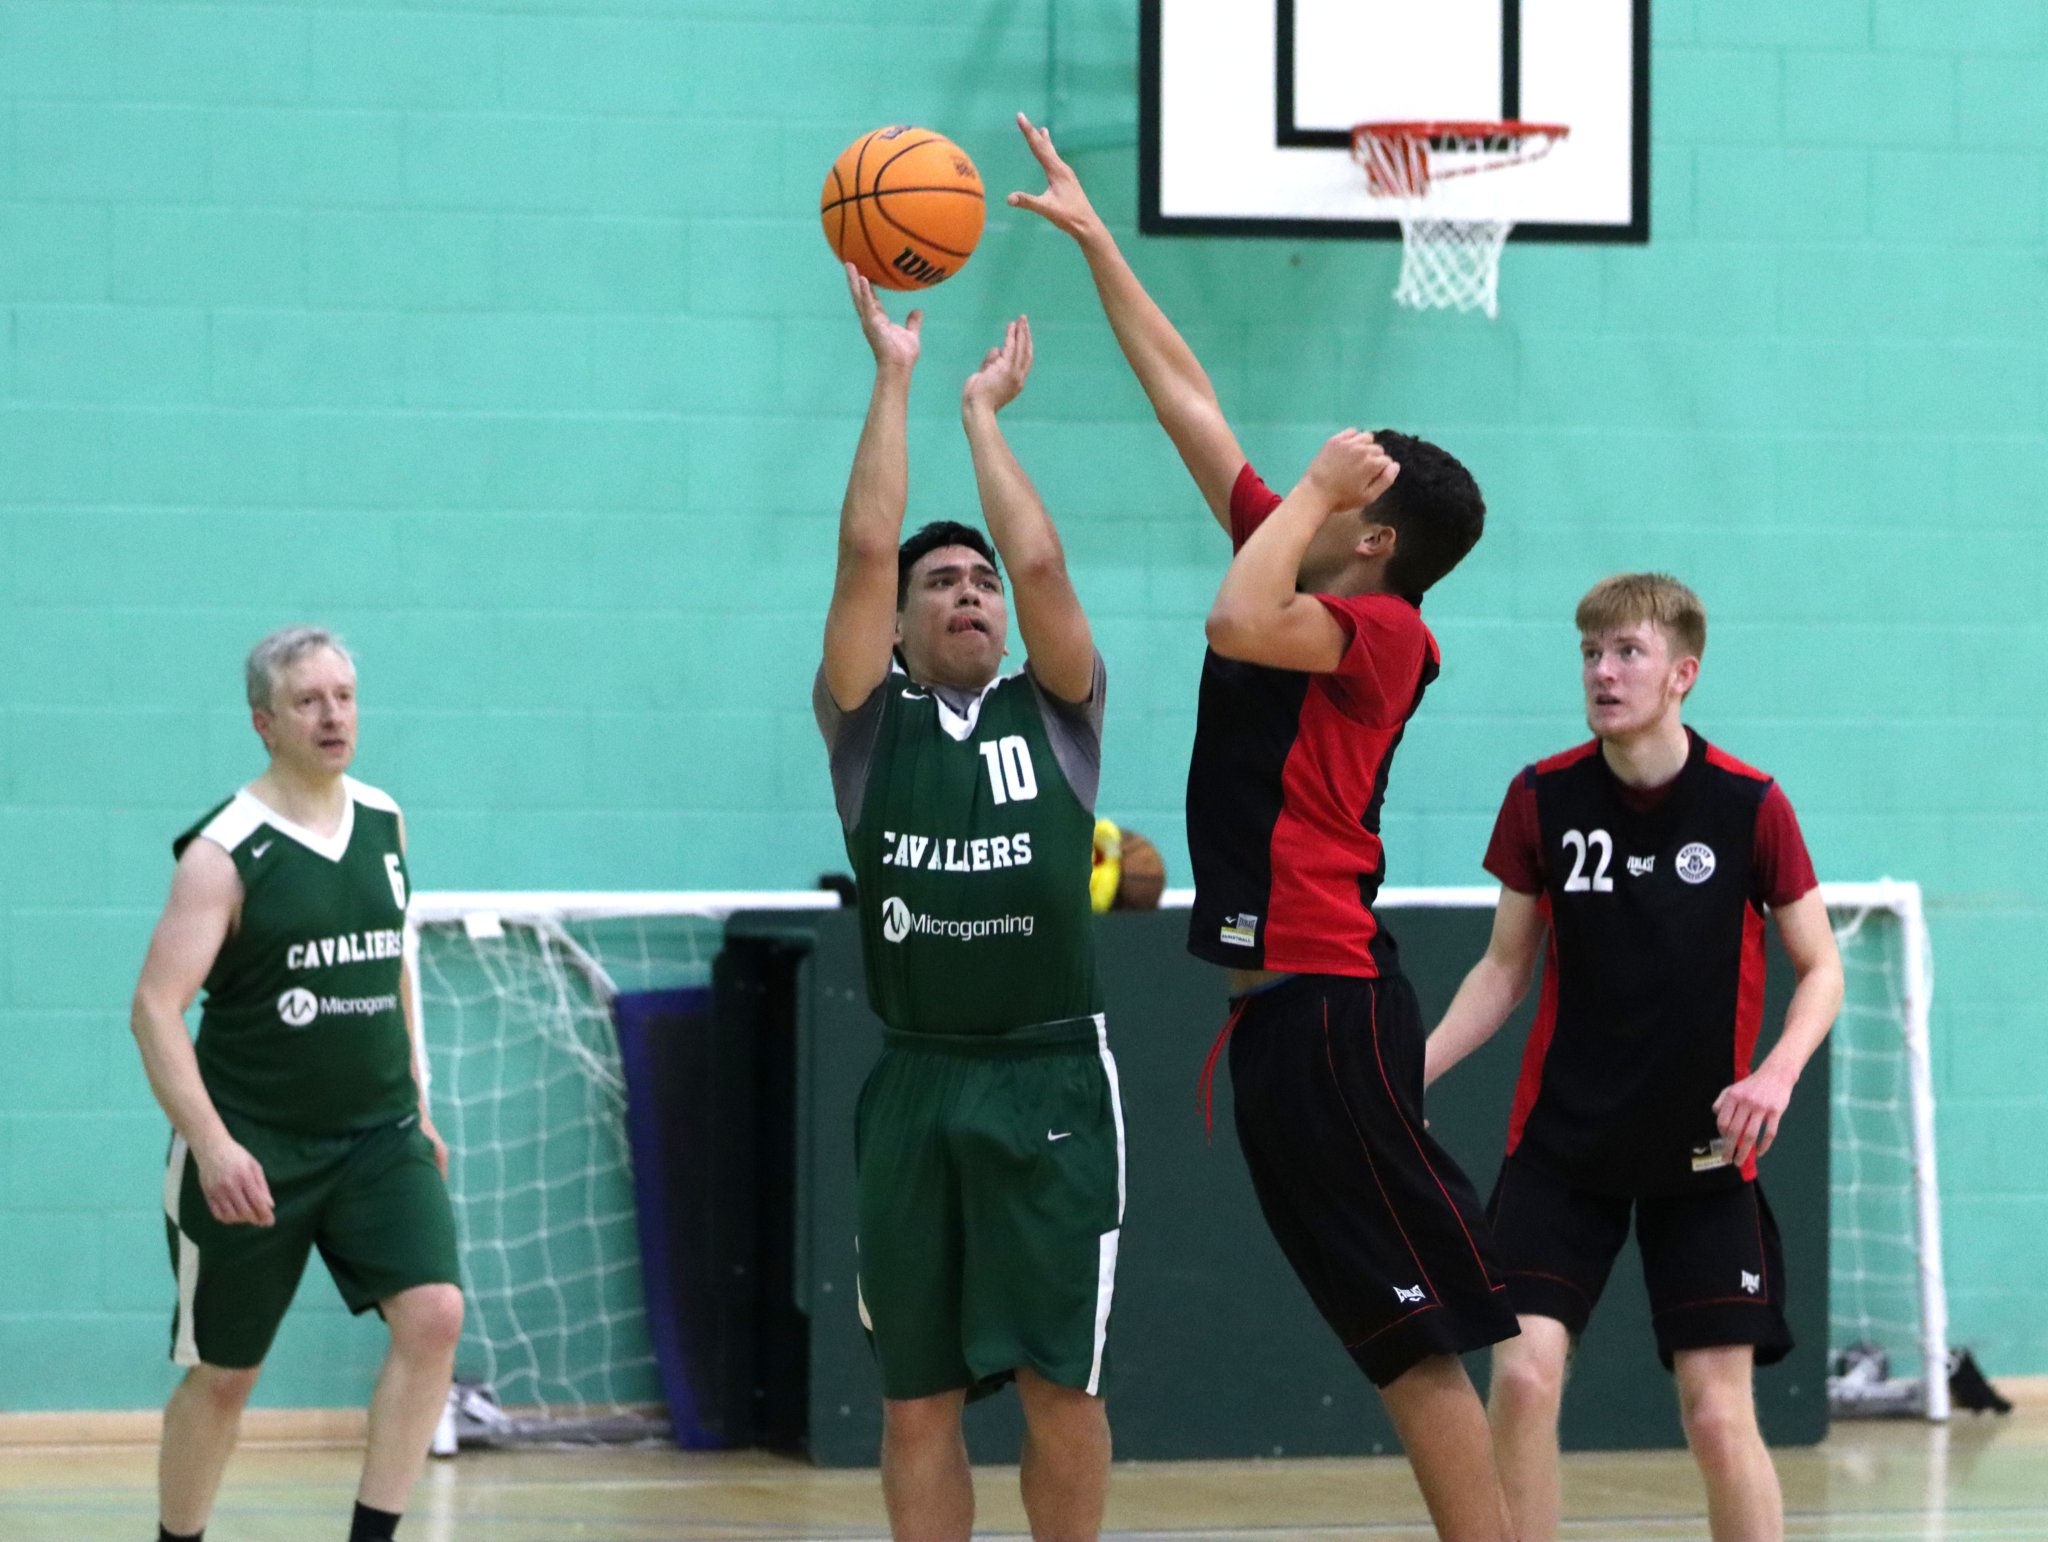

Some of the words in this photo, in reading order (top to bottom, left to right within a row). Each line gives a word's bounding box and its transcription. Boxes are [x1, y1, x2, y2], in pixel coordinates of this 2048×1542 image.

[979, 735, 1038, 805] 10
[1562, 828, 1614, 892] 22
[911, 913, 1034, 942] Microgaming
